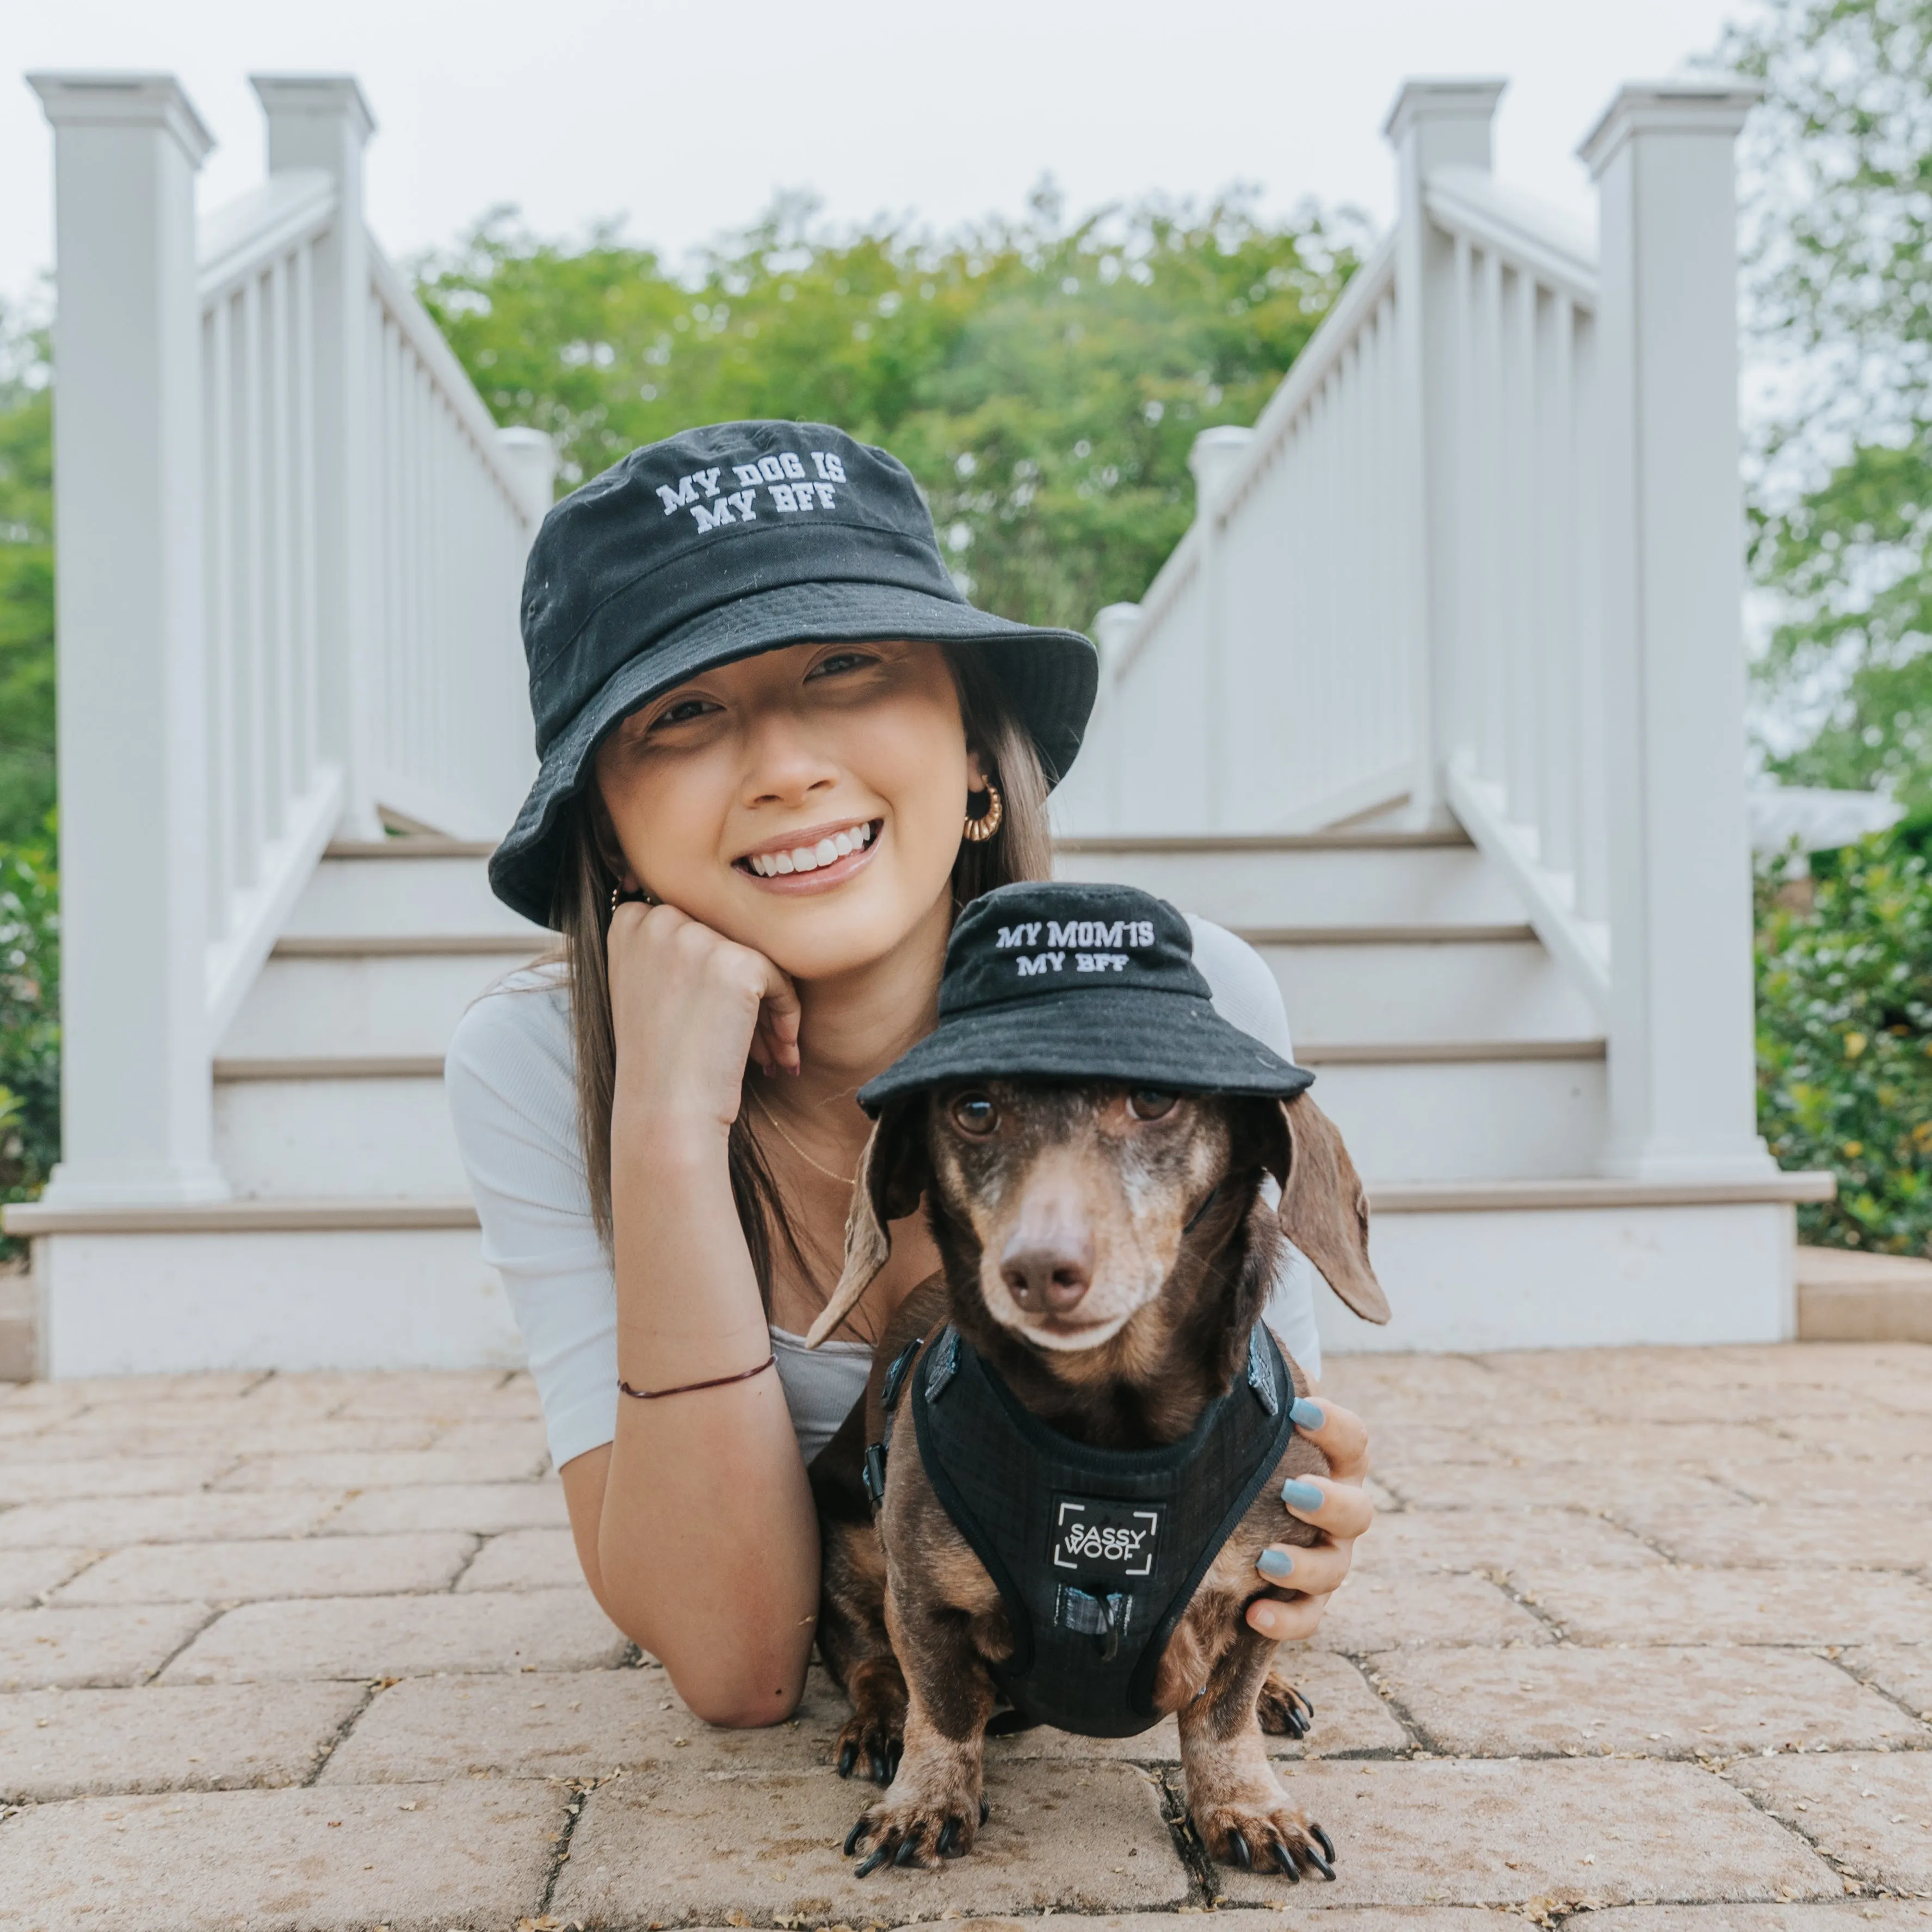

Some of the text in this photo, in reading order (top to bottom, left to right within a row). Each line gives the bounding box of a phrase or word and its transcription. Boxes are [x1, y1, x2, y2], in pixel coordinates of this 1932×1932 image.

[656, 452, 847, 516] MY DOG IS
[690, 482, 836, 534] MY BFF
[996, 921, 1155, 948] MY MOM IS
[1016, 951, 1129, 976] MY BFF
[1070, 1523, 1146, 1546] SASSY
[1065, 1536, 1140, 1561] WOOF
